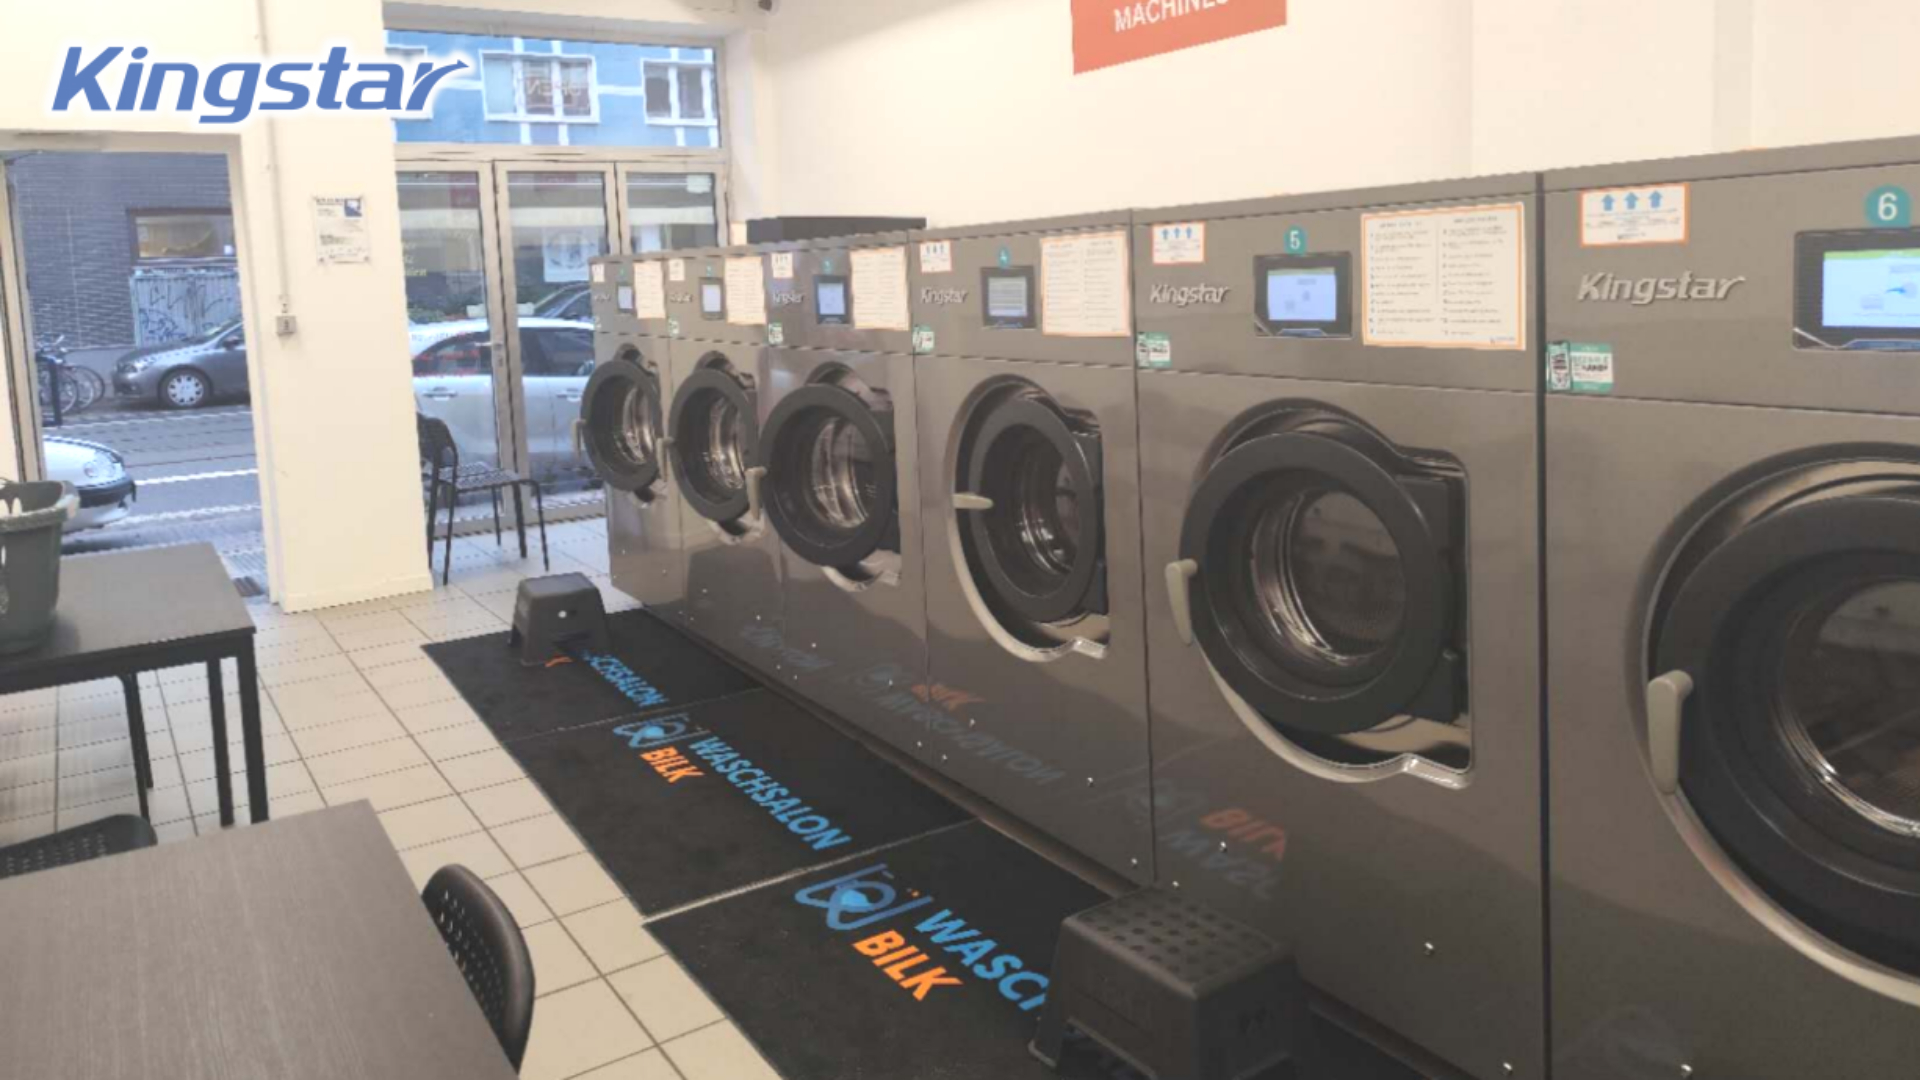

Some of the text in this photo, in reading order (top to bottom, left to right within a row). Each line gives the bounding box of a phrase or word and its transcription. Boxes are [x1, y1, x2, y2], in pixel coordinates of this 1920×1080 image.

[1114, 0, 1228, 32] MACHIN
[1877, 192, 1898, 221] 6
[1290, 230, 1301, 250] 5
[920, 286, 969, 305] Kingstar
[1150, 283, 1230, 307] Kingstar
[1577, 270, 1747, 305] Kingstar
[639, 745, 706, 785] BILK
[688, 736, 852, 851] WASCHSALON
[853, 930, 963, 1002] BILK
